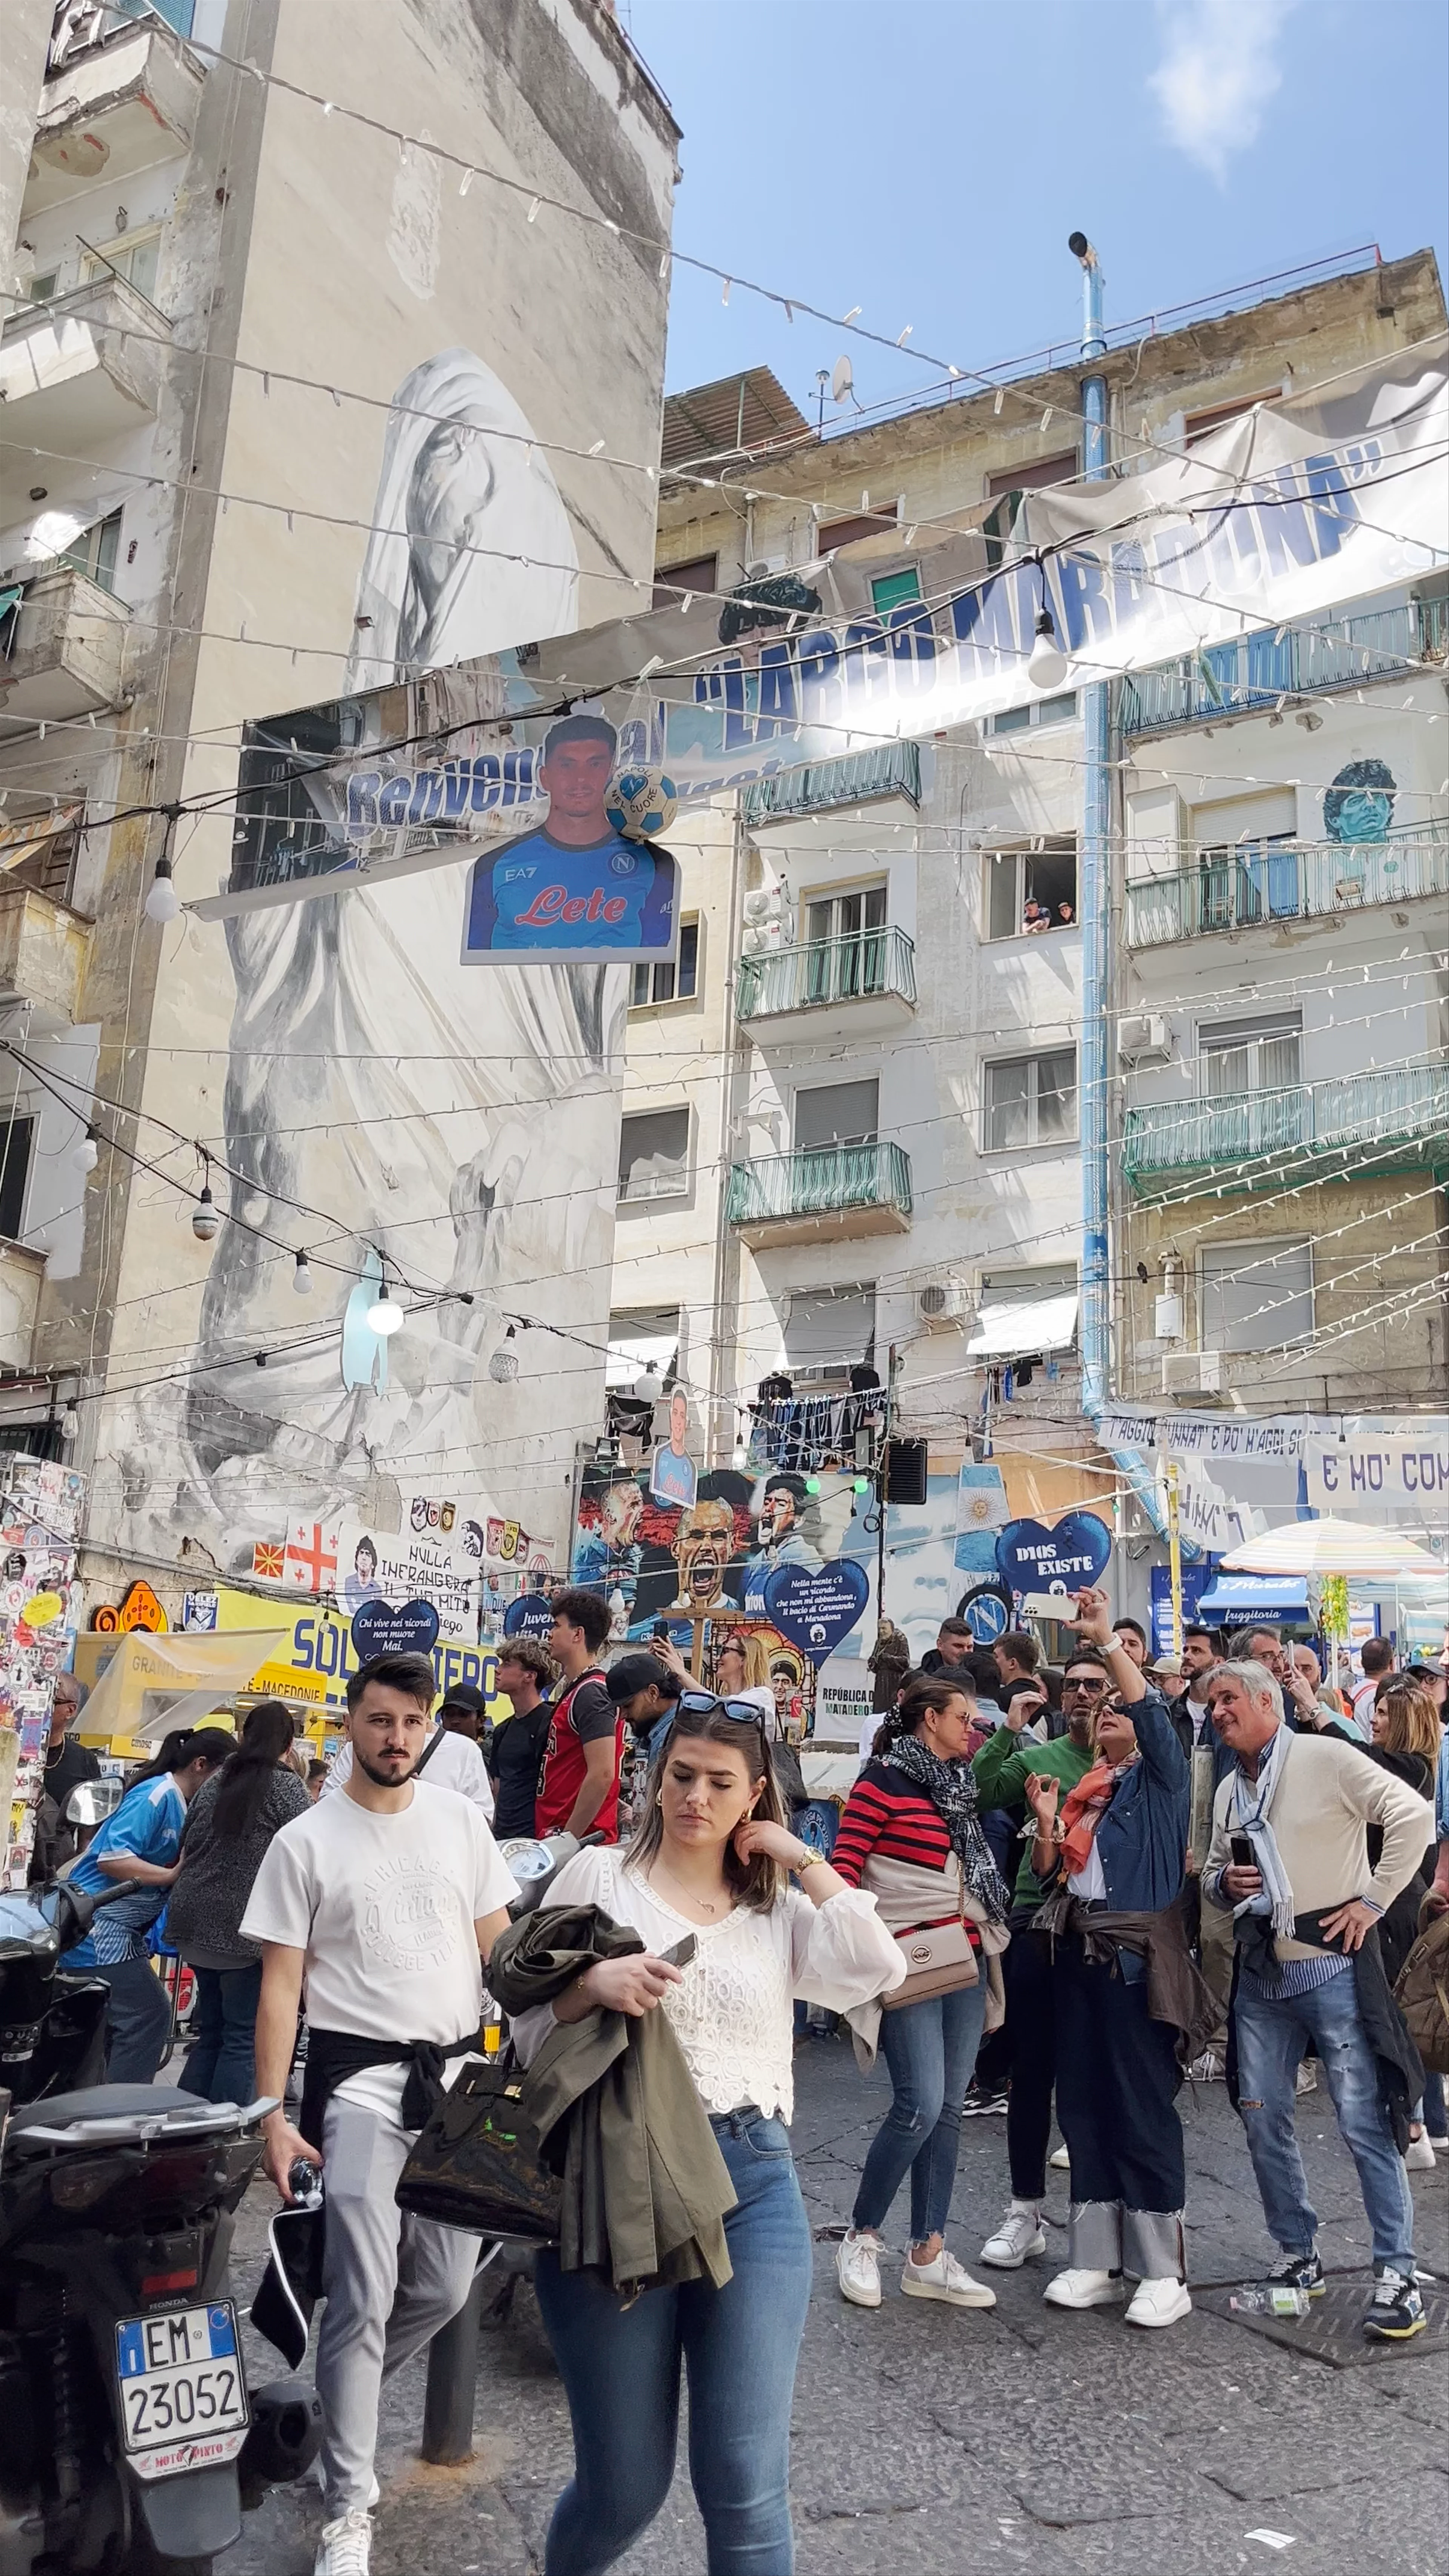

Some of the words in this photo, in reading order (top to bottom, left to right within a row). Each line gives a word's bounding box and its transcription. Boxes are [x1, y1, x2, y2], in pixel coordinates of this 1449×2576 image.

[617, 767, 653, 778] NAPOLI
[611, 789, 625, 809] NEL
[630, 787, 657, 813] CUORE
[505, 867, 537, 882] EA7
[514, 885, 628, 927] Lete
[1323, 1454, 1338, 1491] E
[1350, 1453, 1391, 1491] MO'
[409, 1545, 452, 1570] NULLA
[1037, 1556, 1094, 1576] EXISTE
[791, 1579, 810, 1588] Nella
[833, 1575, 843, 1584] c'è
[811, 1586, 835, 1595] ricordo
[789, 1606, 808, 1615] bacio
[1224, 1609, 1281, 1623] friggitoria
[359, 1618, 372, 1628] Chi
[374, 1618, 389, 1628] vive
[390, 1618, 403, 1628] nei
[404, 1617, 432, 1627] ricordi
[805, 1614, 841, 1623] Maradona
[382, 1640, 403, 1651] Mai.
[823, 1687, 867, 1702] REPÚBLICA
[825, 1703, 873, 1716] MATADEROS
[149, 2298, 188, 2310] HONDA
[146, 2316, 191, 2367] EM
[128, 2369, 238, 2435] 23052
